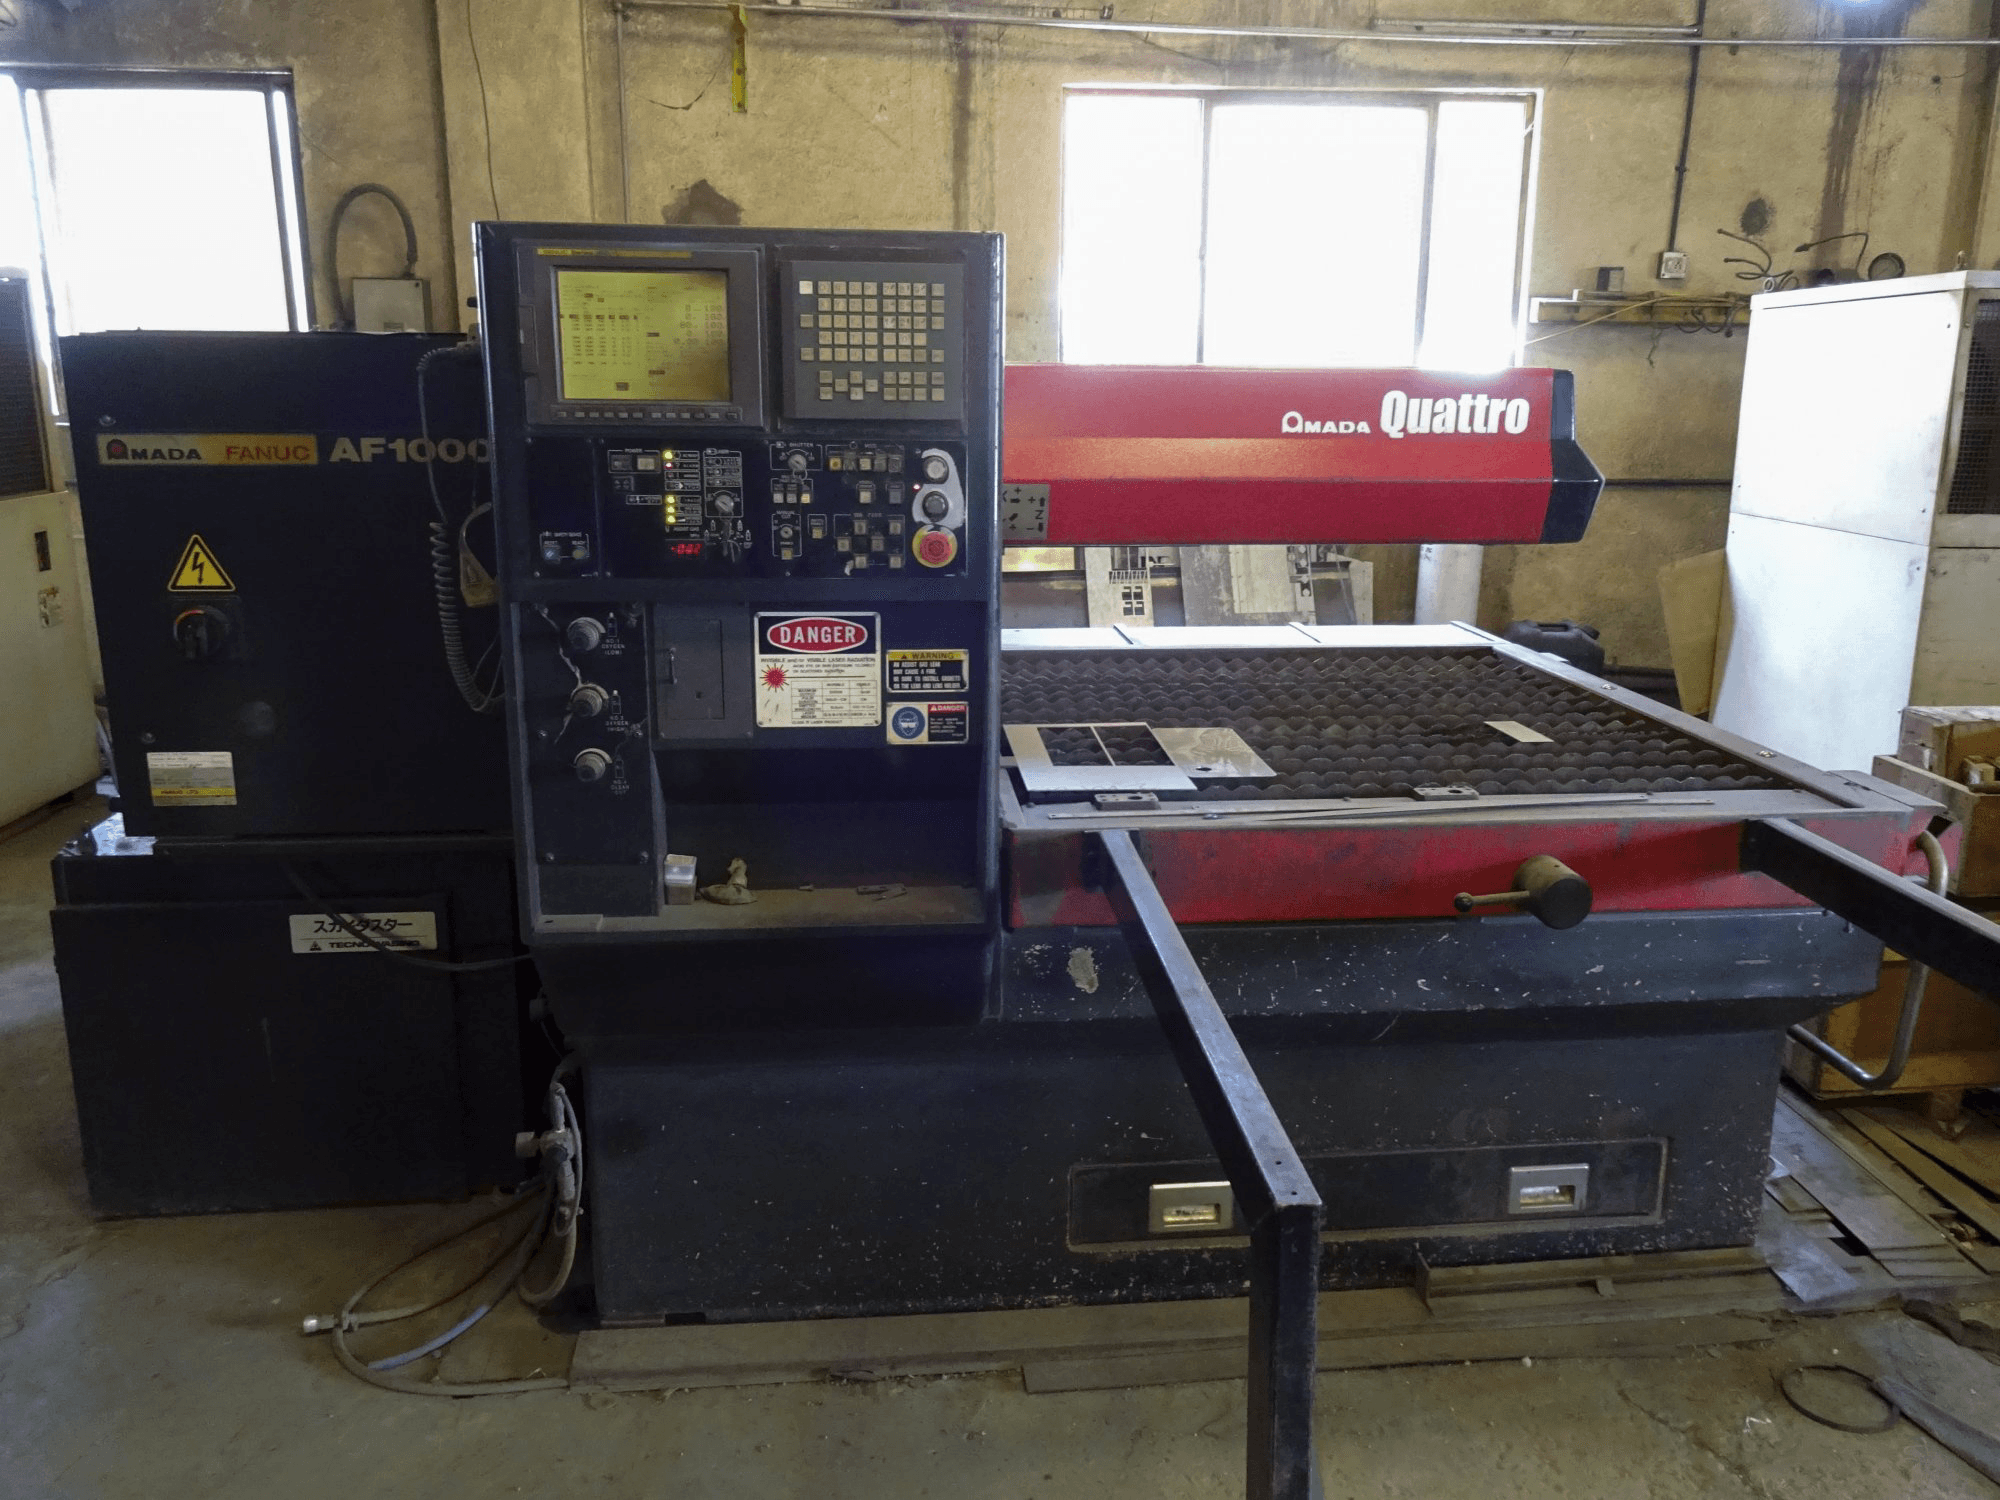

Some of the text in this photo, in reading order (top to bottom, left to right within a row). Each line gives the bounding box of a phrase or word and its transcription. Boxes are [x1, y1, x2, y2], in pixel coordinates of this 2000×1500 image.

[1281, 390, 1531, 439] AMADA Quattro
[225, 446, 311, 462] FANUC
[329, 436, 492, 463] AF1000
[779, 626, 856, 644] DANGER
